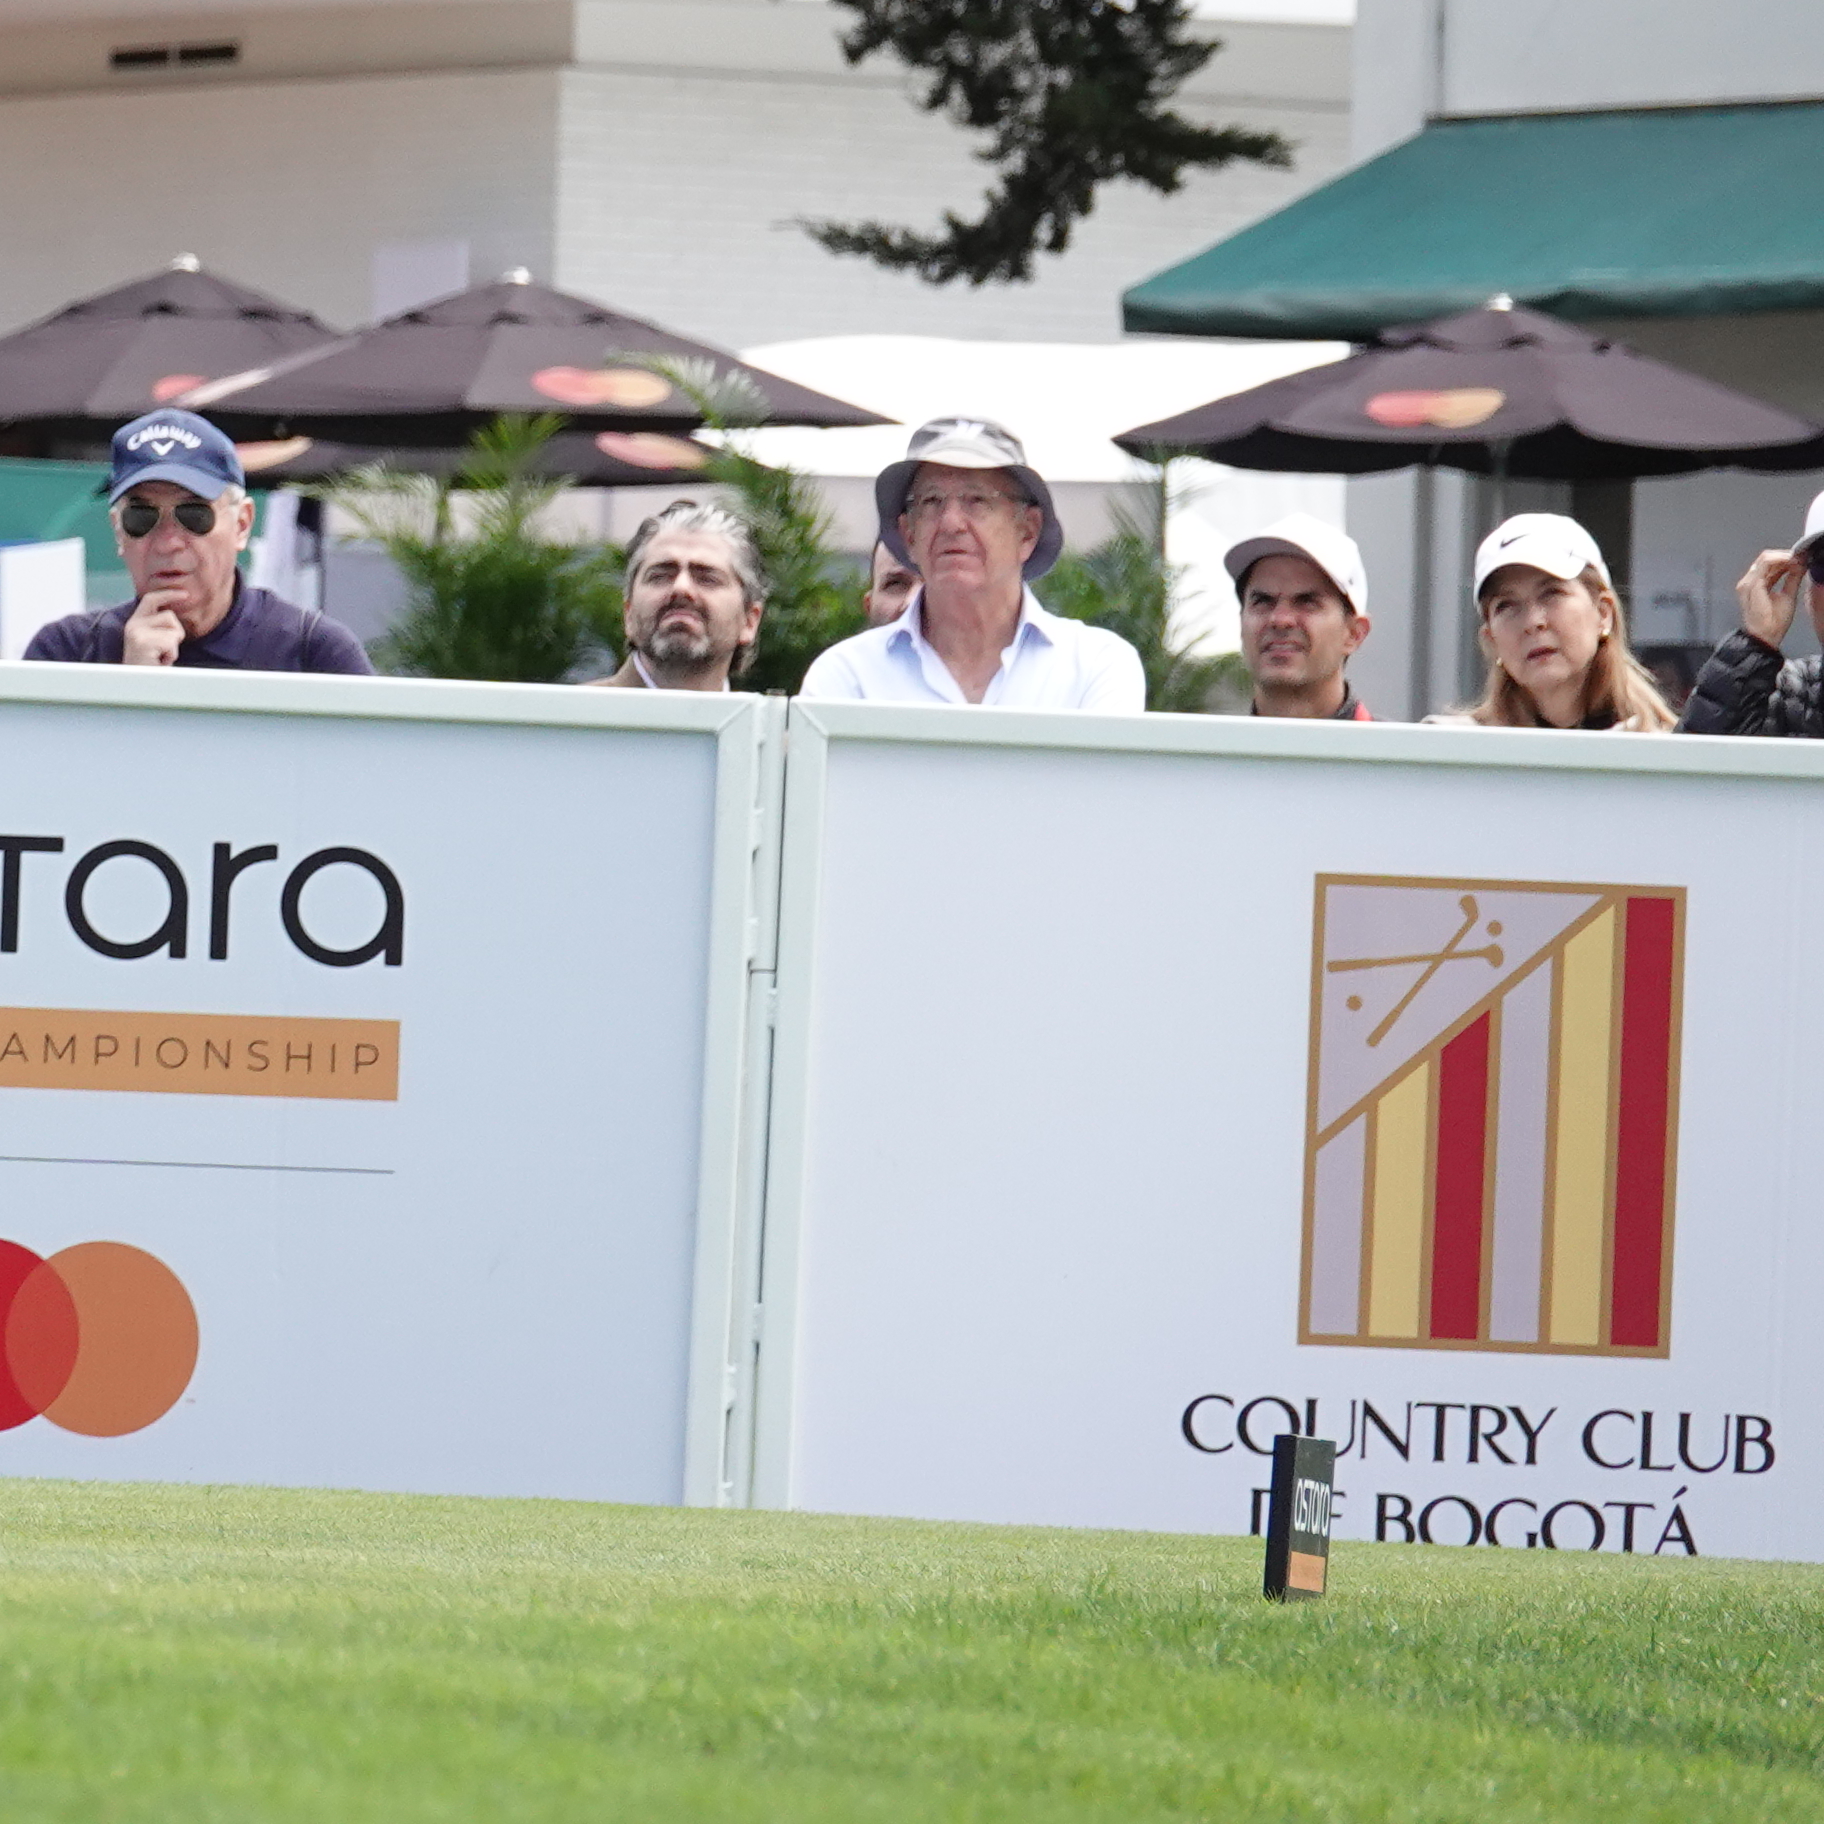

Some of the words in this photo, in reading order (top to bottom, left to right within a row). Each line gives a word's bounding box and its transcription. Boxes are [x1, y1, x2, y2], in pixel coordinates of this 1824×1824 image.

[126, 423, 202, 451] Callaway
[1180, 1393, 1559, 1467] COUNTRY
[1581, 1408, 1777, 1476] CLUB
[1374, 1485, 1699, 1557] BOGOTÁ
